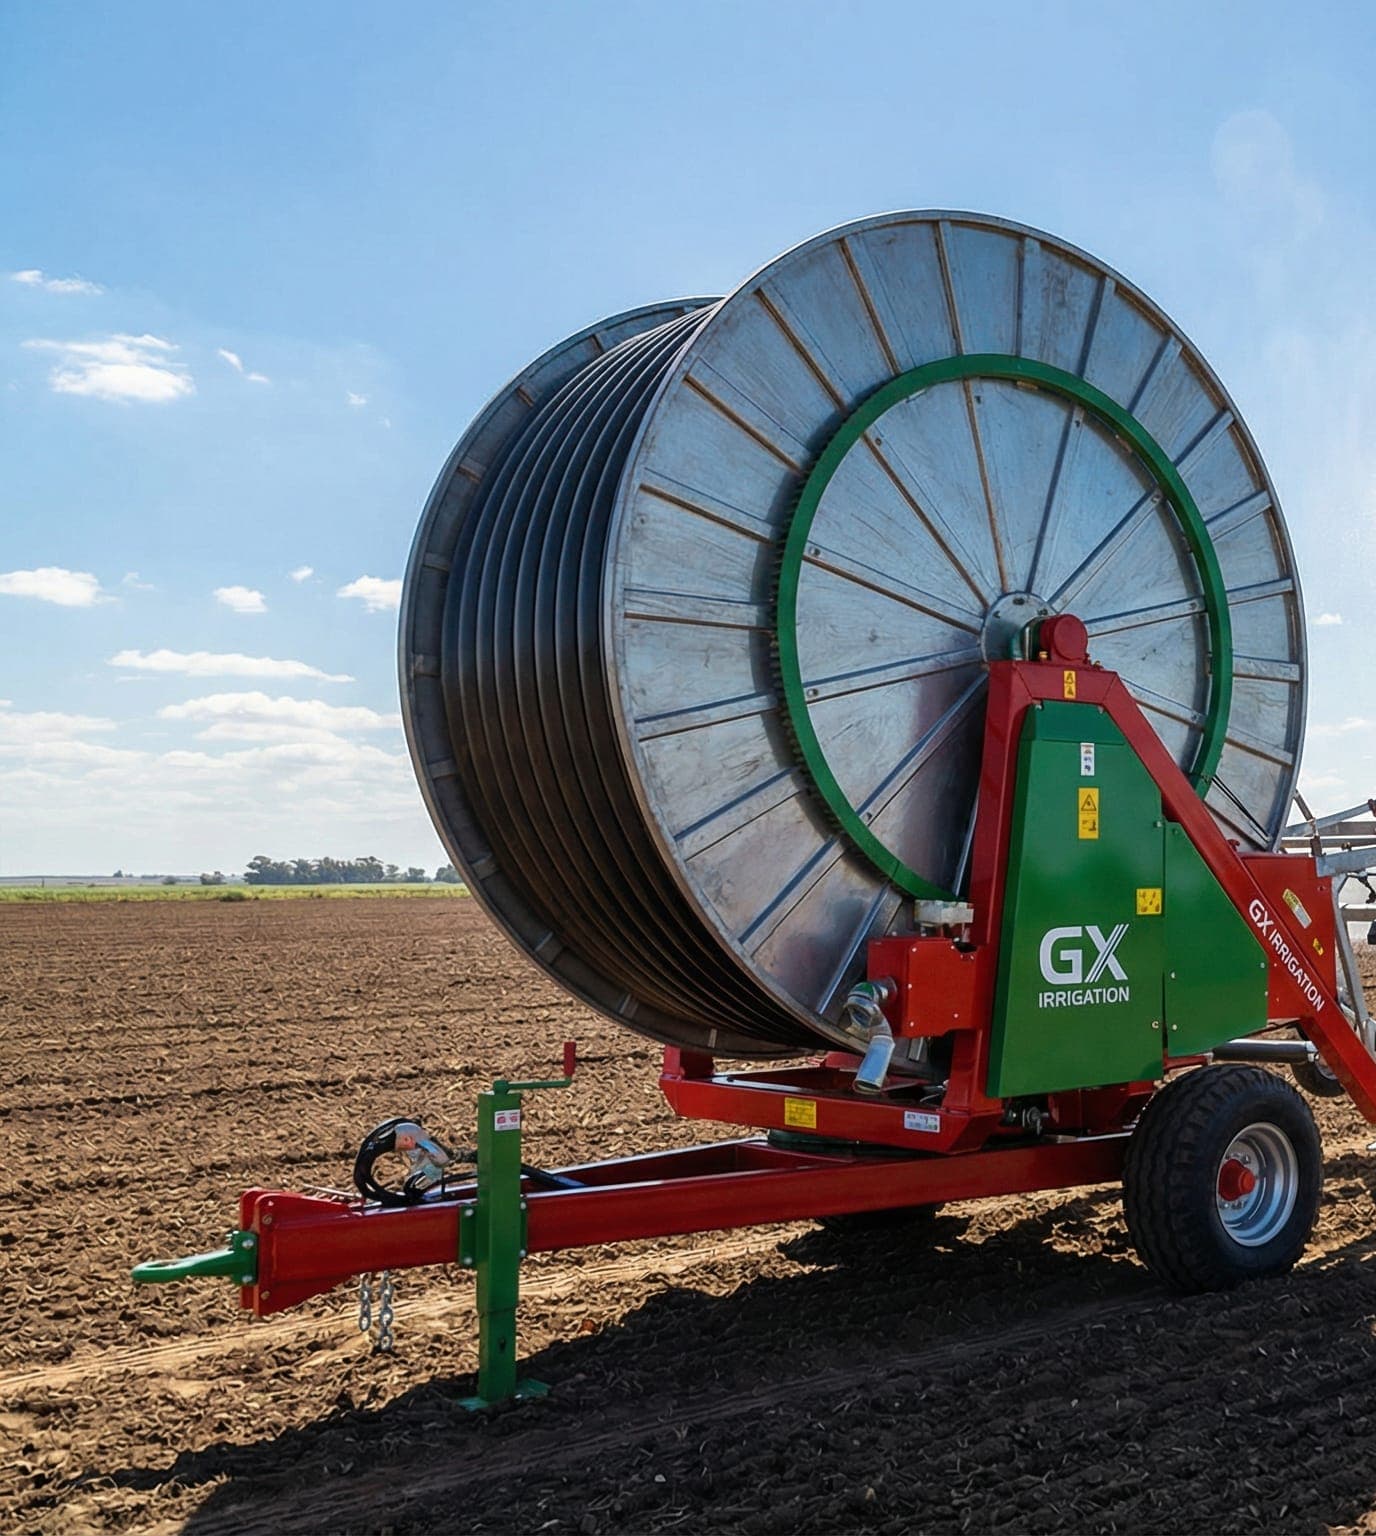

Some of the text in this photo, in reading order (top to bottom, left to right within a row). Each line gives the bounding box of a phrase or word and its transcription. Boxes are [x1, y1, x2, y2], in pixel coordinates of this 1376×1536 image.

[1039, 923, 1130, 985] GX
[1248, 899, 1325, 1012] GX IRRIGATION
[1038, 986, 1130, 1009] IRRIGATION
